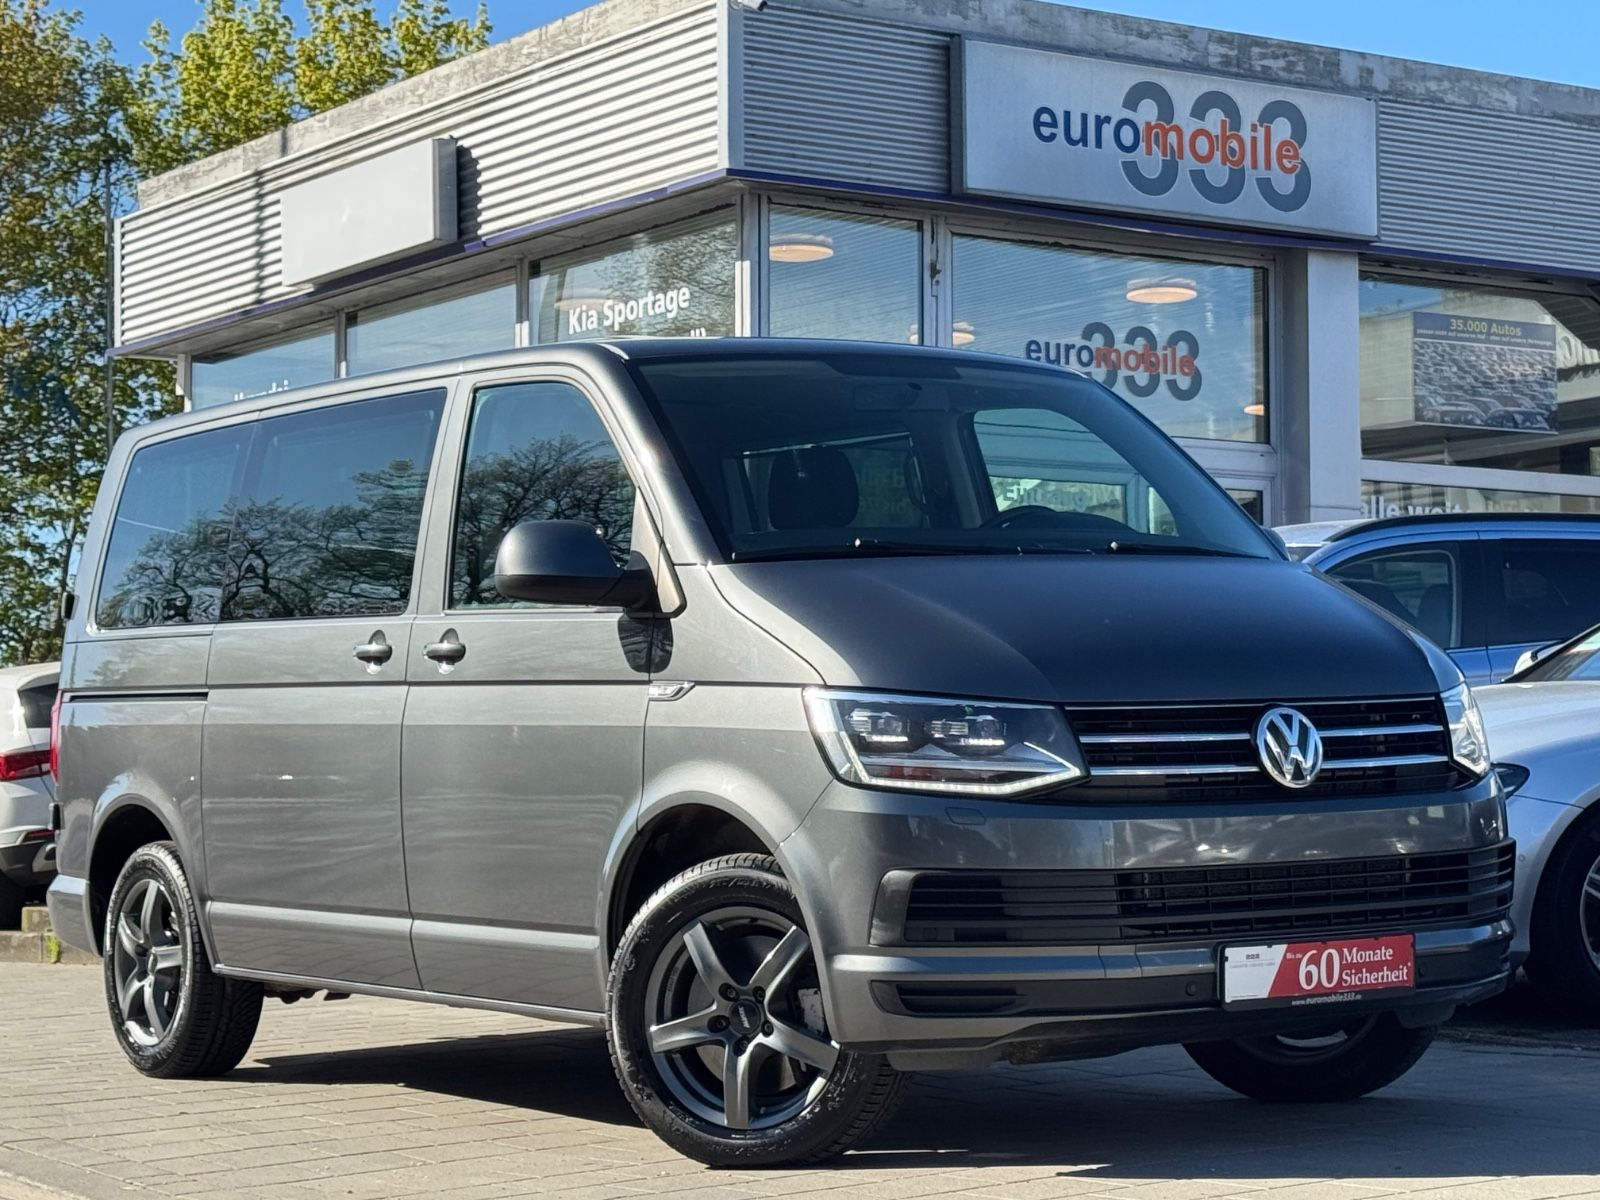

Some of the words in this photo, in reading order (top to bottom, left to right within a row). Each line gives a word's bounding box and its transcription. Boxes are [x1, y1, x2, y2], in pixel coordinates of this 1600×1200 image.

[1033, 106, 1302, 175] euromobile
[568, 305, 598, 334] Kia
[602, 287, 690, 330] Sportage
[1449, 318, 1488, 333] 35.000
[1490, 323, 1522, 336] Autos
[1025, 339, 1197, 377] euromobile
[1298, 948, 1340, 990] 60
[1342, 946, 1394, 964] Monate
